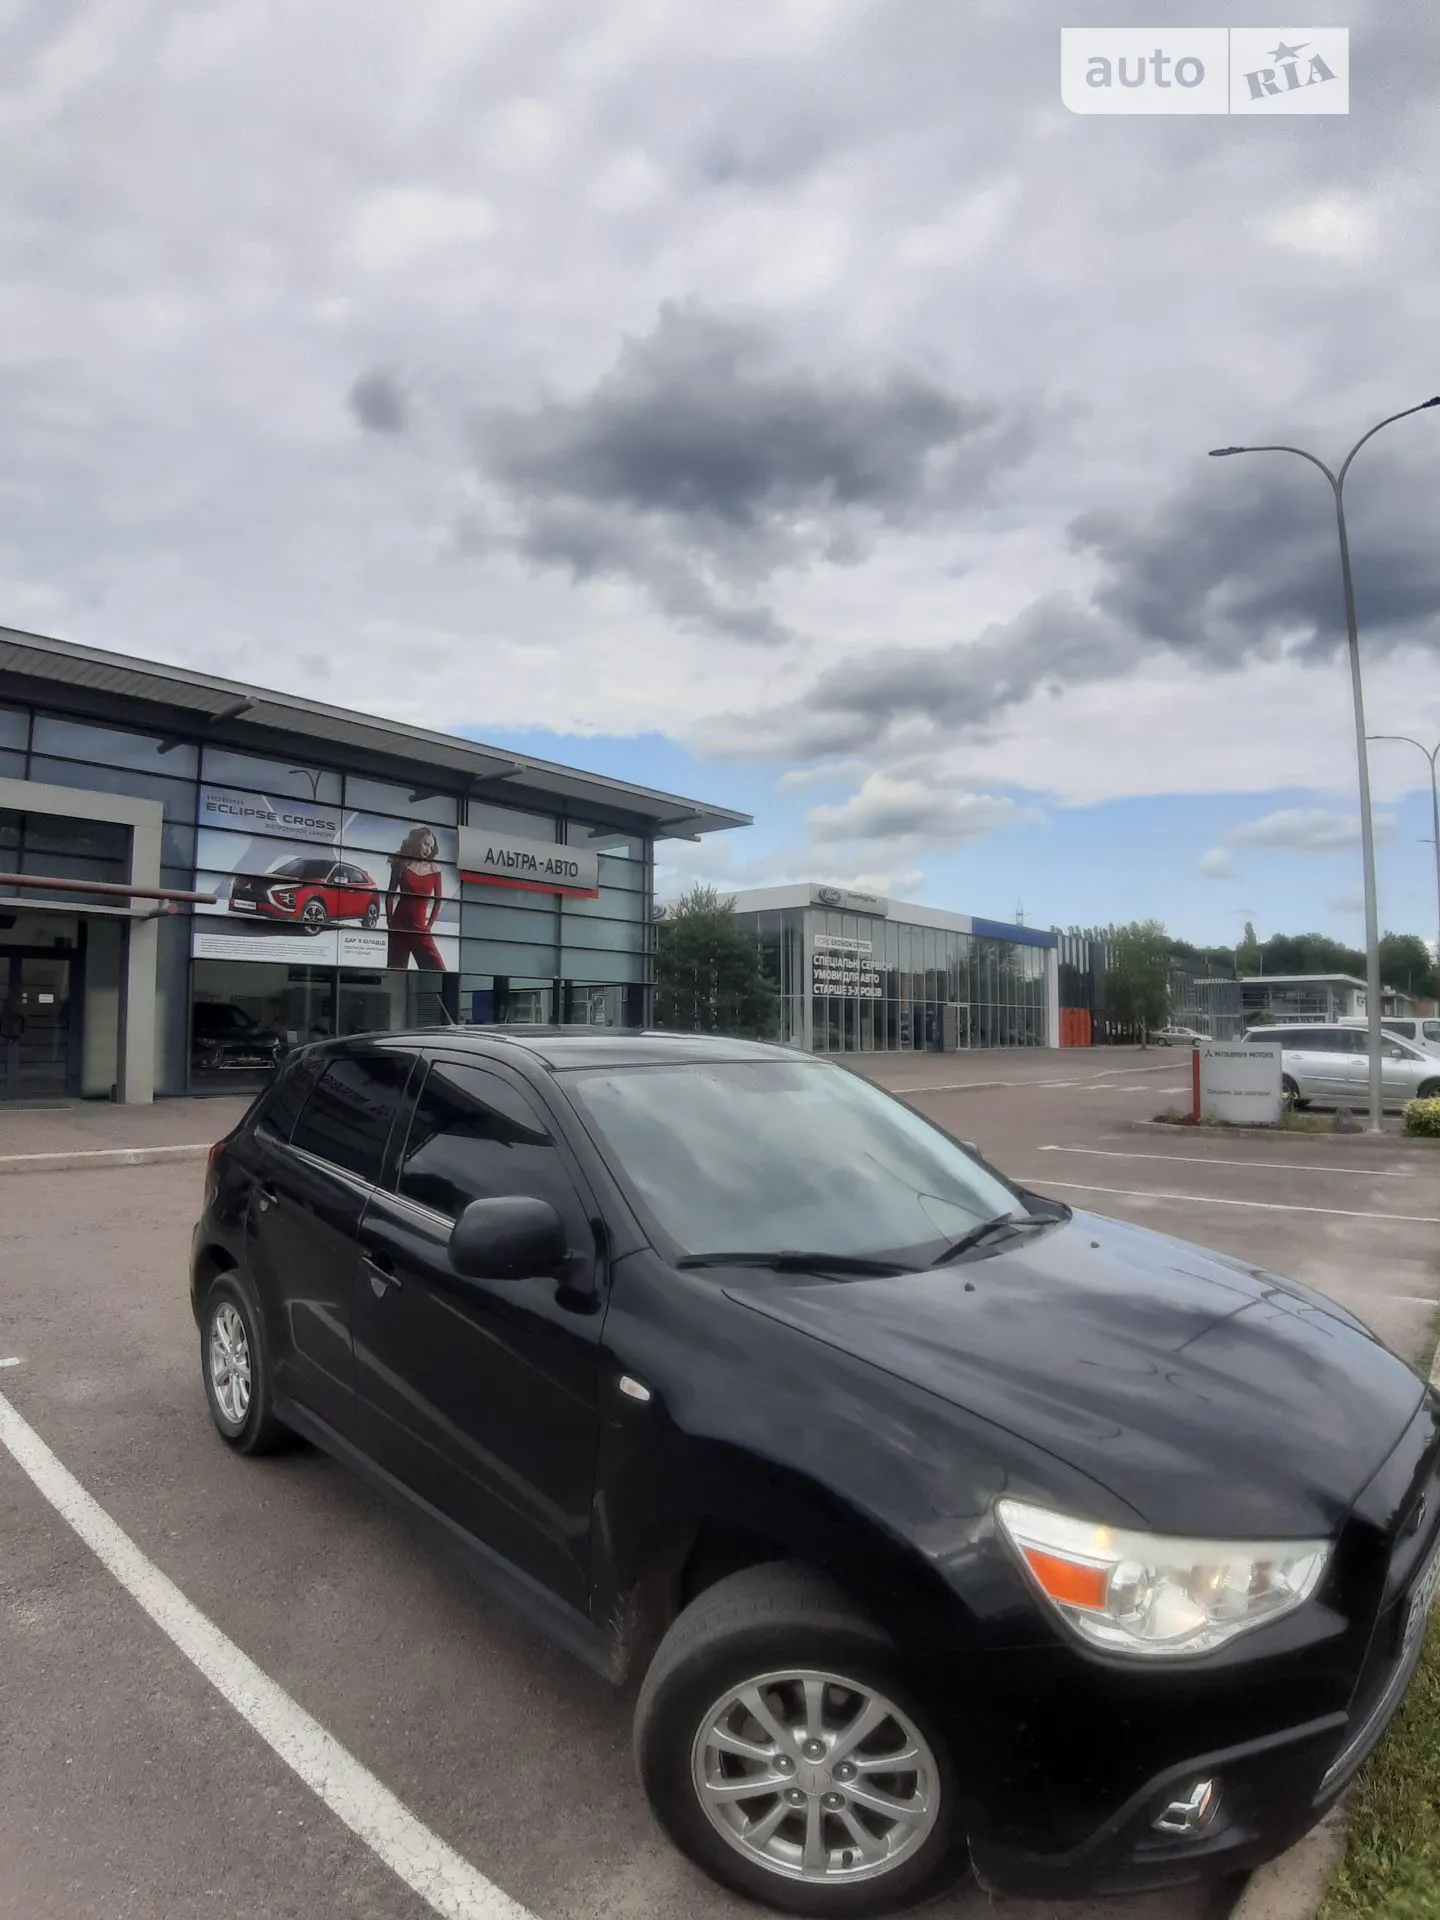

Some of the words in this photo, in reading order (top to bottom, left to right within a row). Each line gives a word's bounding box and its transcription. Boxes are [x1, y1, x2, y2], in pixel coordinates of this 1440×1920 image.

[206, 802, 277, 821] ECLIPSE
[282, 814, 337, 831] CROSS
[813, 968, 842, 980] УМОВИ
[860, 973, 880, 984] АВТО
[813, 983, 847, 996] СТАРШЕ
[860, 987, 882, 997] РОКІВ
